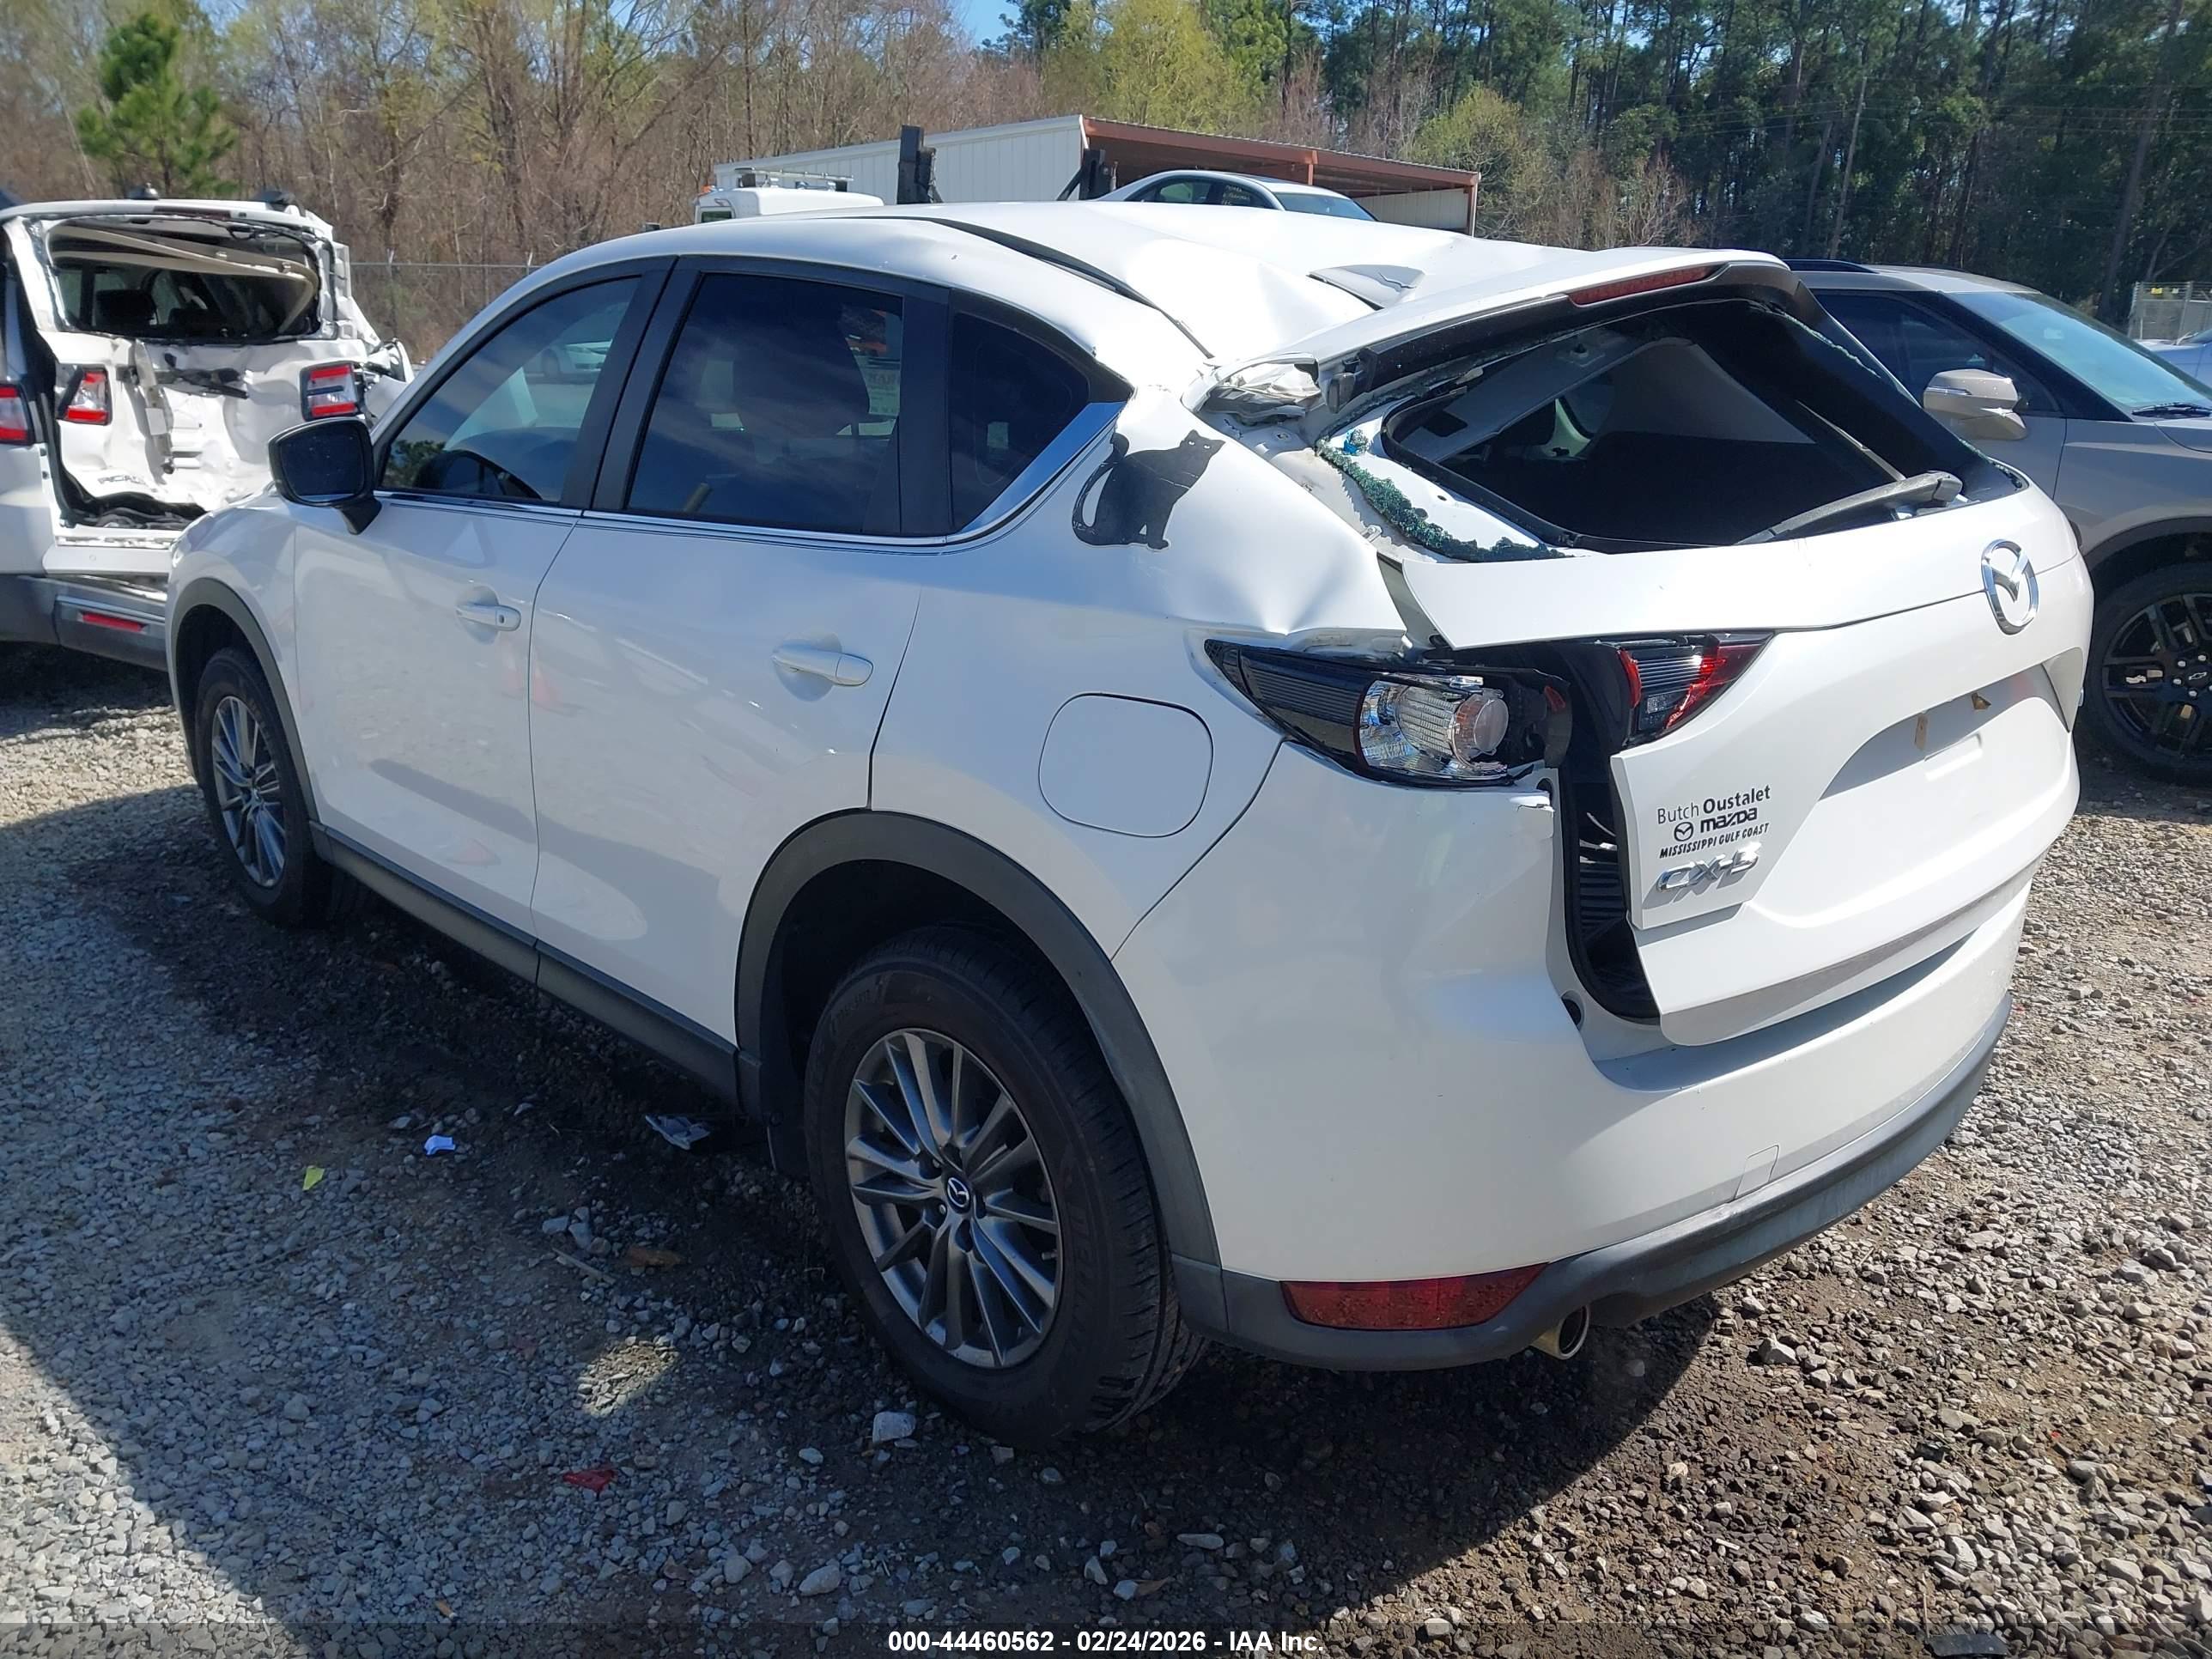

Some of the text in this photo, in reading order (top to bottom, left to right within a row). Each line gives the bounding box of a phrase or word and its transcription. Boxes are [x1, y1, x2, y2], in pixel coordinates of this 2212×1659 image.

[1657, 785, 1771, 824] Butch Oustalet
[1659, 823, 1770, 859] MISSISSIPPI GULF COAST
[1656, 842, 1761, 892] CX-5
